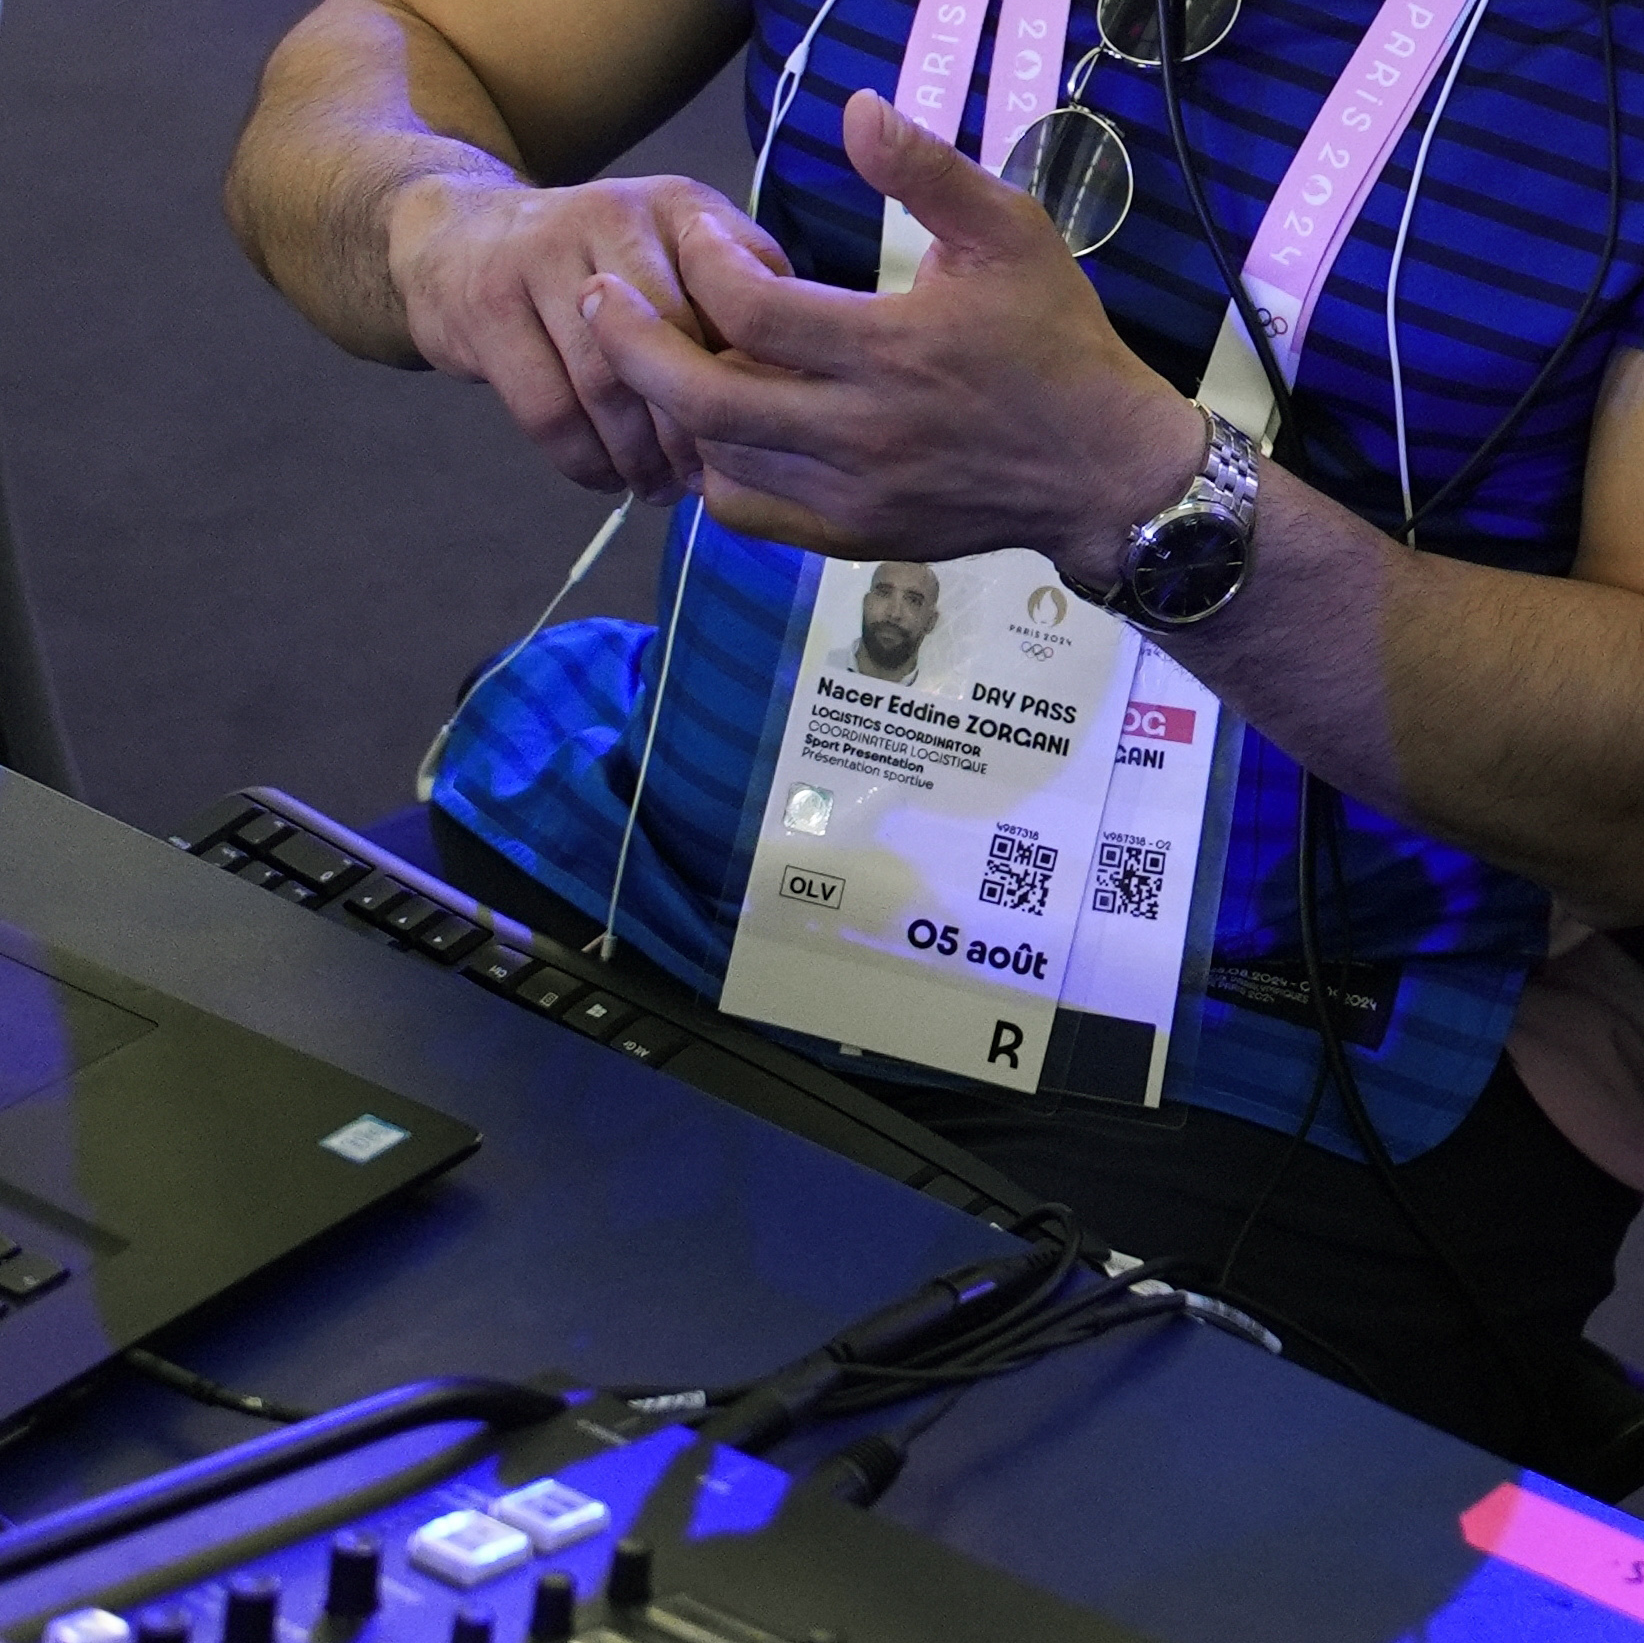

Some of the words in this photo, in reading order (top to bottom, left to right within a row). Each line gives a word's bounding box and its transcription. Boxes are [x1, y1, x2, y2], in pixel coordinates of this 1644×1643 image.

[1269, 141, 1350, 266] 2024
[1043, 633, 1073, 647] 2024
[817, 677, 885, 709] Nacer
[888, 695, 960, 729] Eddine
[965, 714, 1071, 757] ZORGANI
[971, 682, 1017, 709] DAY
[1020, 695, 1078, 724] PASS
[808, 720, 909, 754] COORDINATEUR
[910, 746, 989, 775] LOGISTIQUE
[811, 704, 881, 732] LOGISTICS
[883, 723, 982, 757] COORDINATOR
[801, 747, 881, 777] Présentation
[883, 769, 934, 790] sportive
[804, 733, 840, 753] Sport
[842, 742, 925, 774] Presentation
[996, 822, 1040, 841] 4987318
[1103, 831, 1146, 846] 4987318
[789, 876, 837, 901] OLV
[966, 942, 1048, 980] août
[987, 1019, 1024, 1069] R
